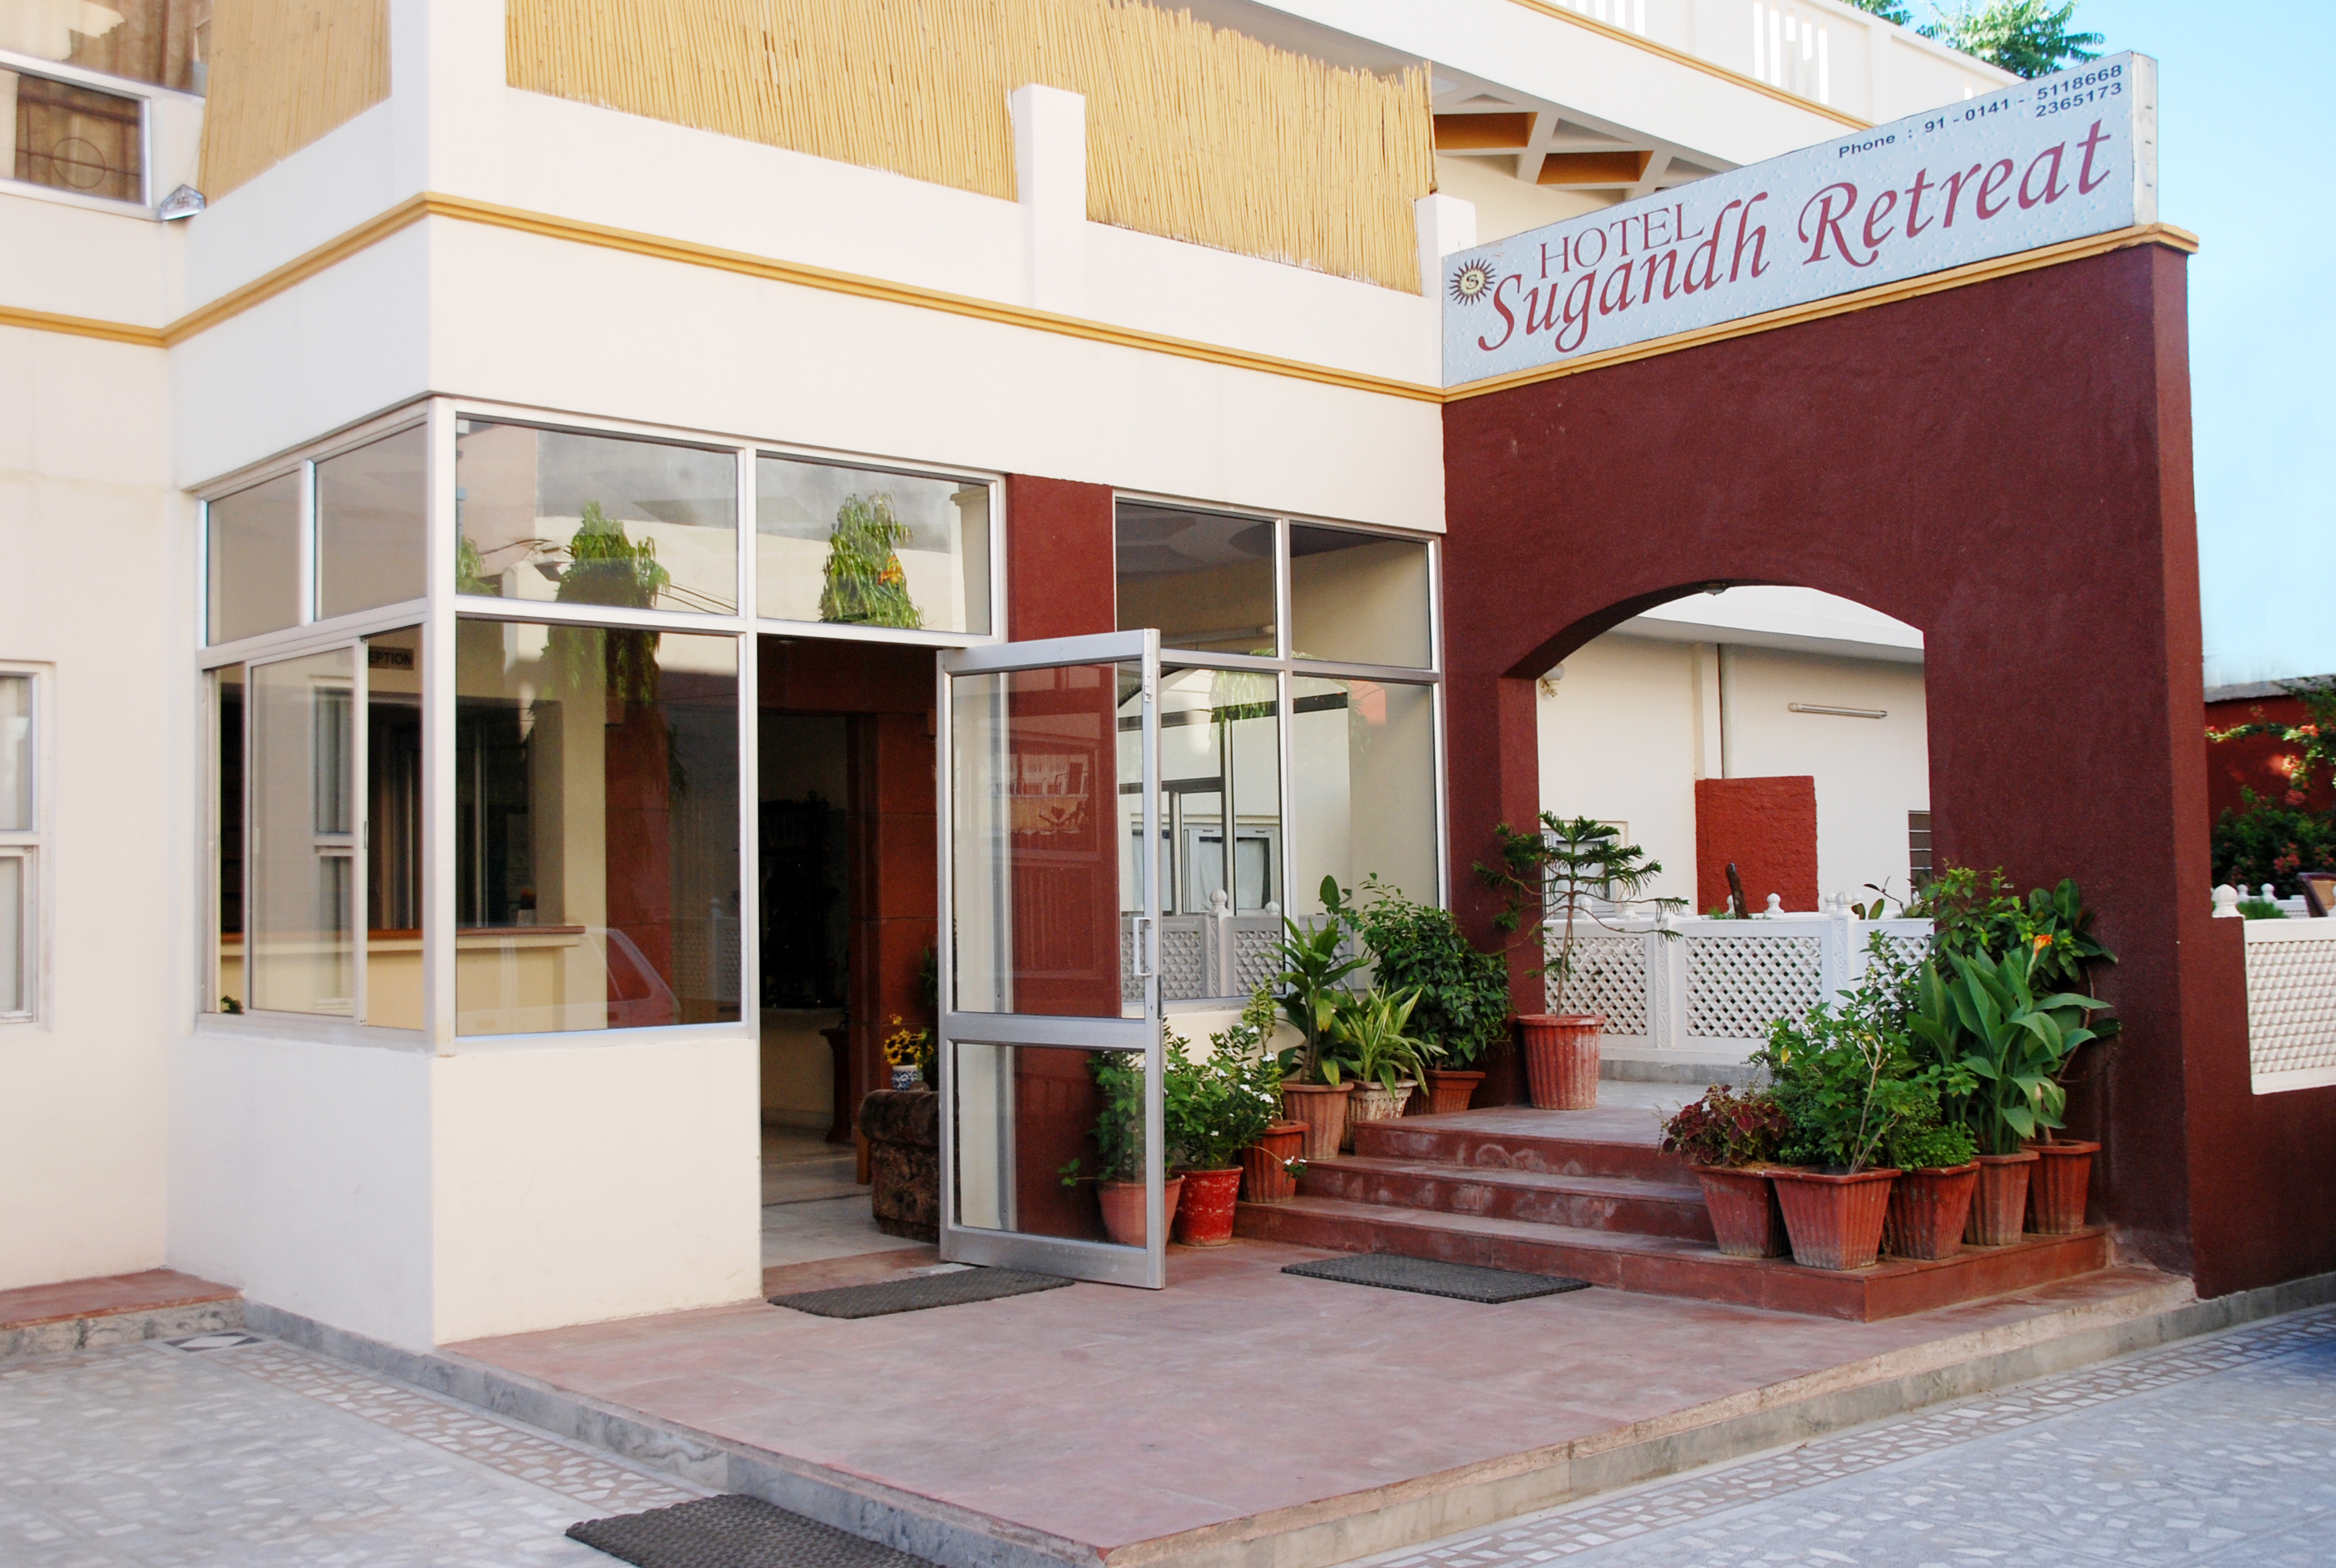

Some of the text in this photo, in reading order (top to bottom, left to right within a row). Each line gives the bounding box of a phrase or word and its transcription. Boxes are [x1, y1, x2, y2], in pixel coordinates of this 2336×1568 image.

[1838, 134, 1896, 158] Phone
[1924, 117, 1946, 133] 91
[1965, 98, 2011, 122] 0141
[2036, 64, 2123, 101] 5118668
[2034, 81, 2123, 118] 2365173
[1478, 119, 2112, 353] Sugandh Retreat
[1540, 202, 1704, 280] HOTEL
